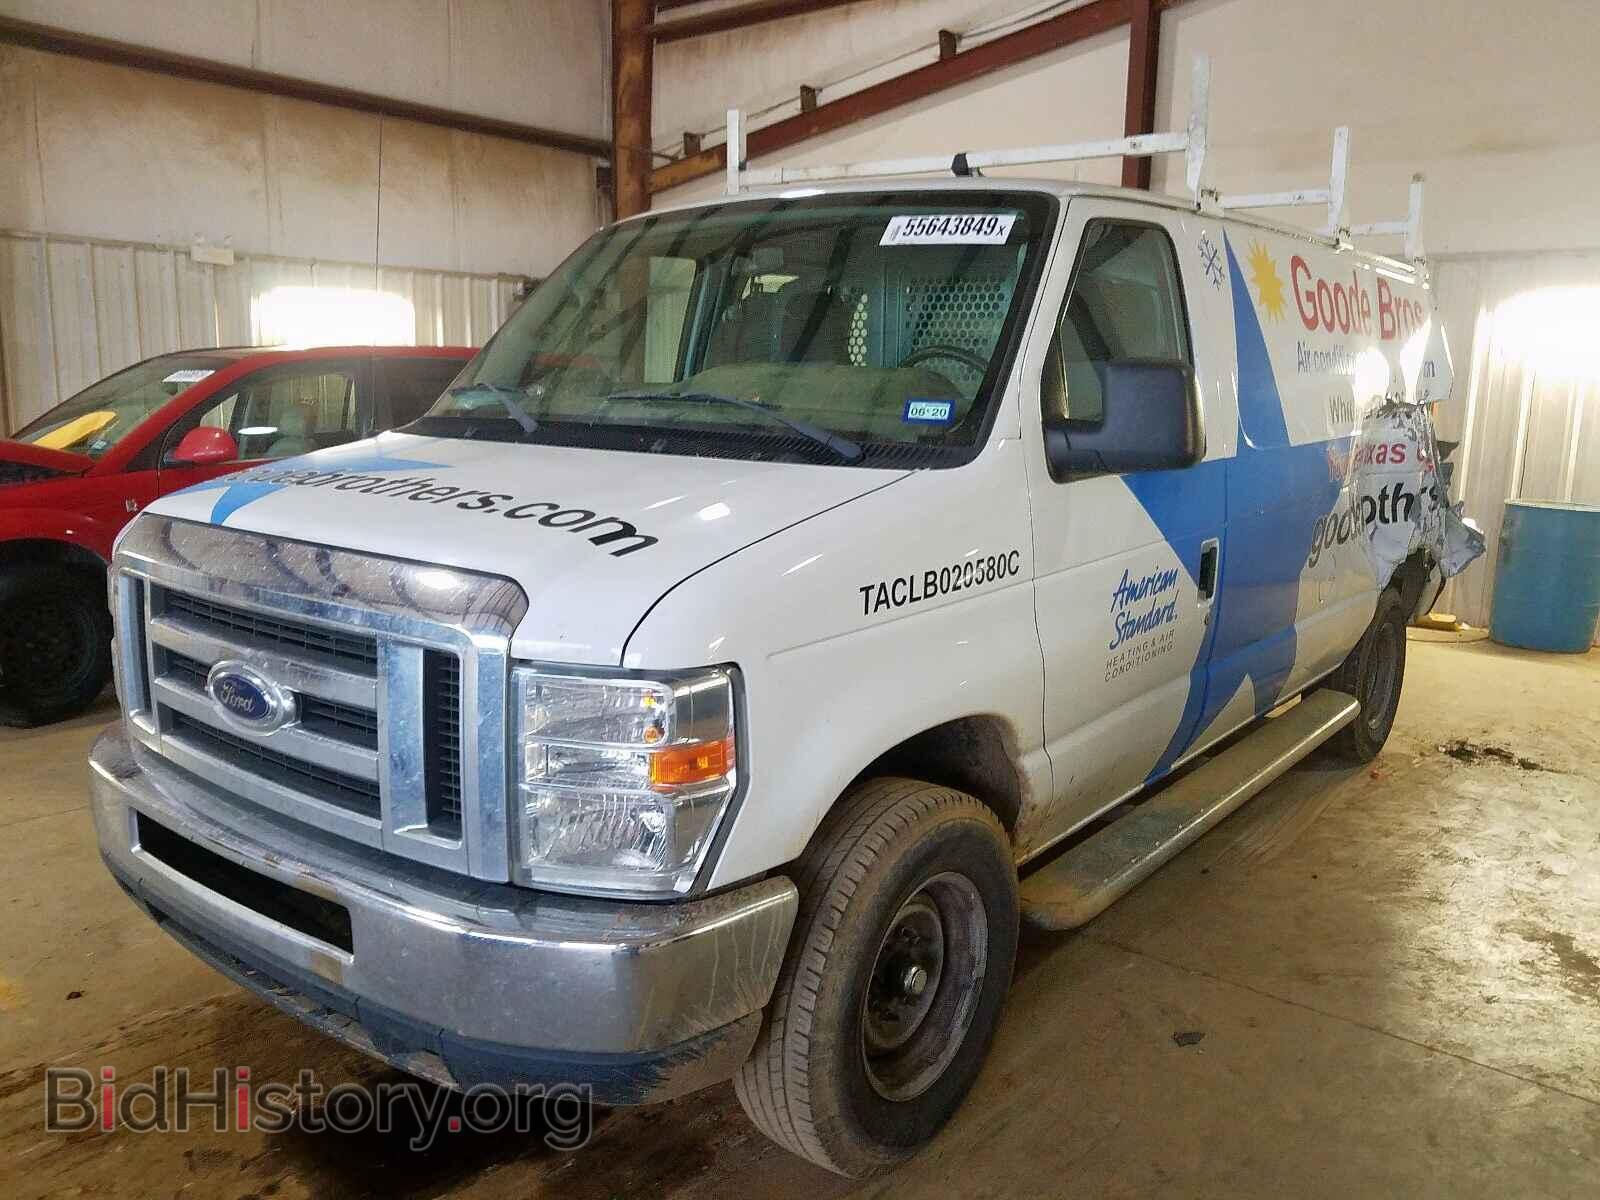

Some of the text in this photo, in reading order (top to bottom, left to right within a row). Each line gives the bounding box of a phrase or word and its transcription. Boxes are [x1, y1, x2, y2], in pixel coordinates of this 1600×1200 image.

[1290, 255, 1371, 337] Goode
[859, 549, 1020, 616] TACLB020580C
[1110, 565, 1178, 613] American
[1104, 640, 1175, 682] CONDITIONING
[1106, 641, 1149, 669] HEATING
[1159, 629, 1175, 643] AIR
[221, 681, 257, 713] Ford
